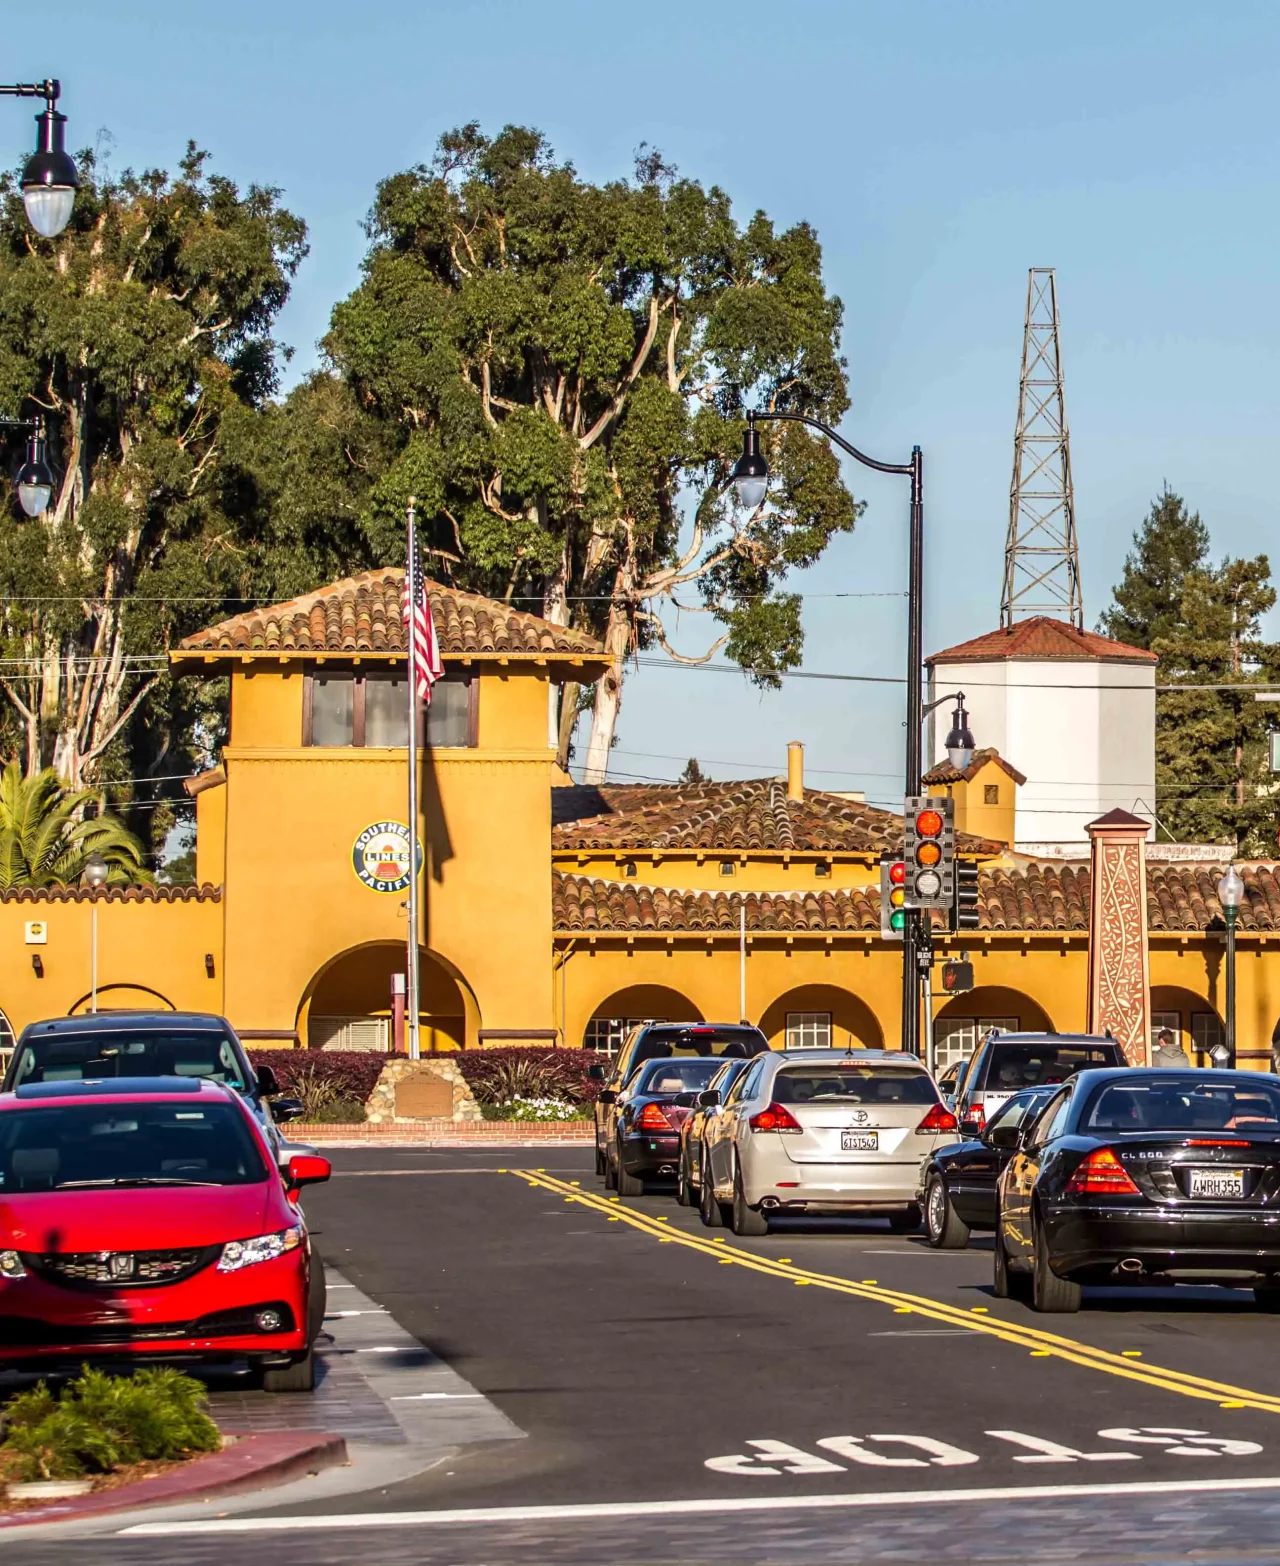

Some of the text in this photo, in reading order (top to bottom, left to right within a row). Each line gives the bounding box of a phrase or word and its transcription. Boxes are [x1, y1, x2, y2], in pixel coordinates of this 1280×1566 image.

[355, 822, 421, 851] SOUTHE
[367, 852, 409, 861] LINES
[359, 869, 411, 891] PACIFI
[1193, 1179, 1241, 1194] 4WRH355
[703, 1427, 1264, 1476] STOP
